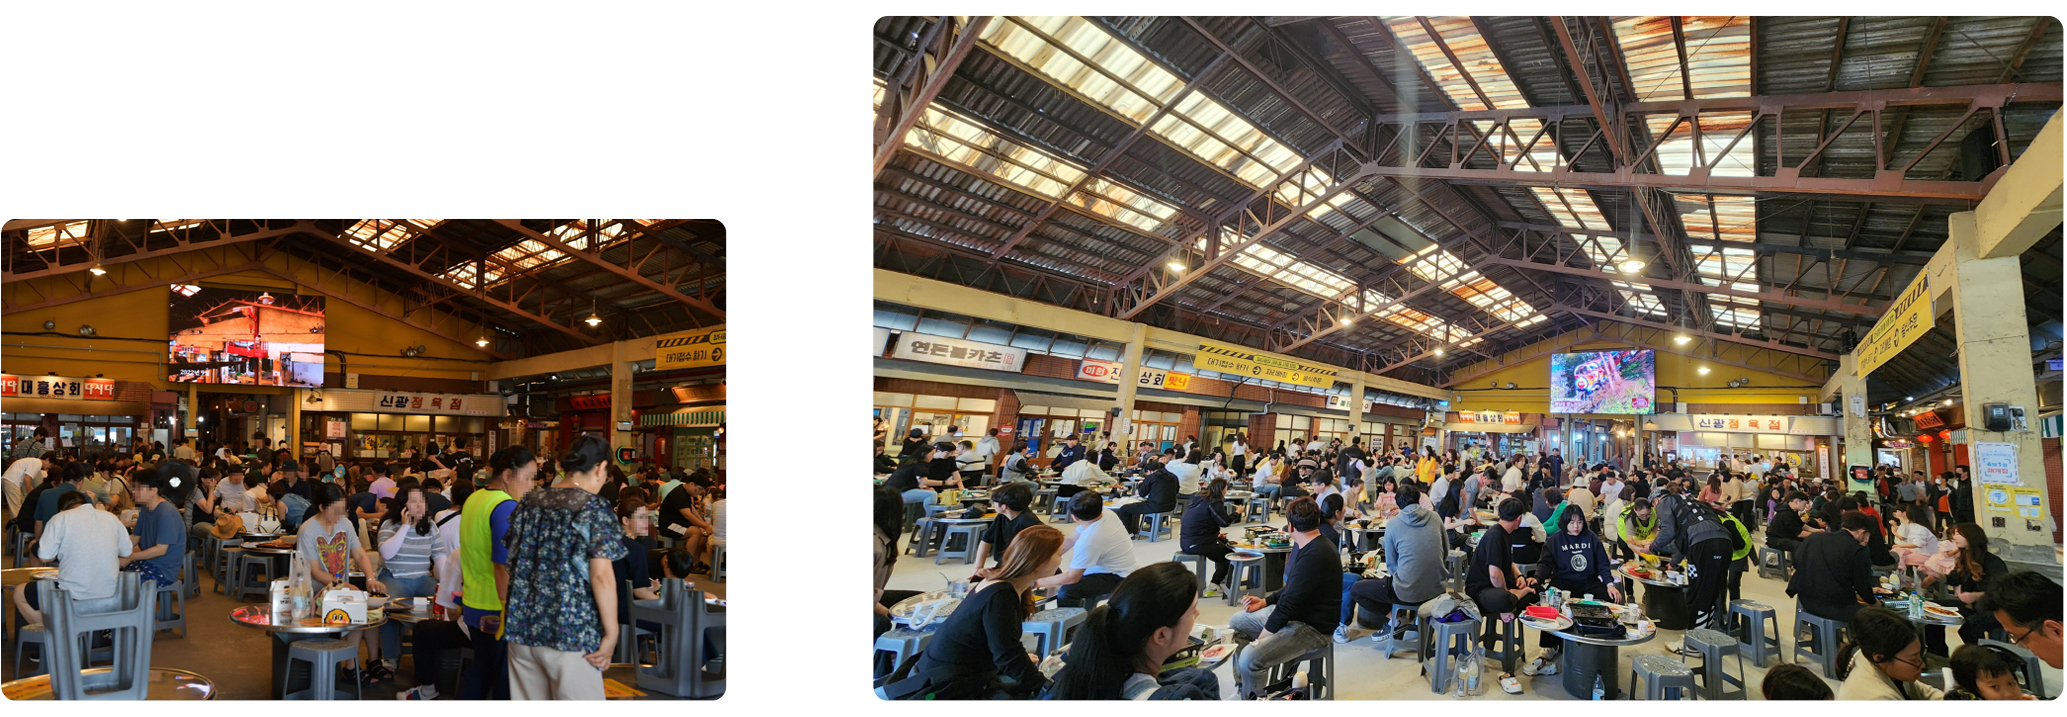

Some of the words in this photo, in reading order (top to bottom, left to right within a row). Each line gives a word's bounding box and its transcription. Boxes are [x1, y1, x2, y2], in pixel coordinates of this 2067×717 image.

[666, 352, 692, 363] 대기접수
[693, 350, 708, 361] 하기
[911, 340, 1003, 363] 연돈볼카츠
[1207, 357, 1235, 370] 대기접수
[1236, 362, 1249, 371] 하기
[1110, 367, 1165, 386] 진상회
[21, 379, 81, 396] 대흥상회
[84, 382, 114, 396] 다시다
[380, 395, 409, 409] 신광
[411, 396, 462, 411] 정육점
[1699, 418, 1725, 429] 신광
[1728, 418, 1780, 430] 정육점
[1561, 542, 1591, 551] MARDI
